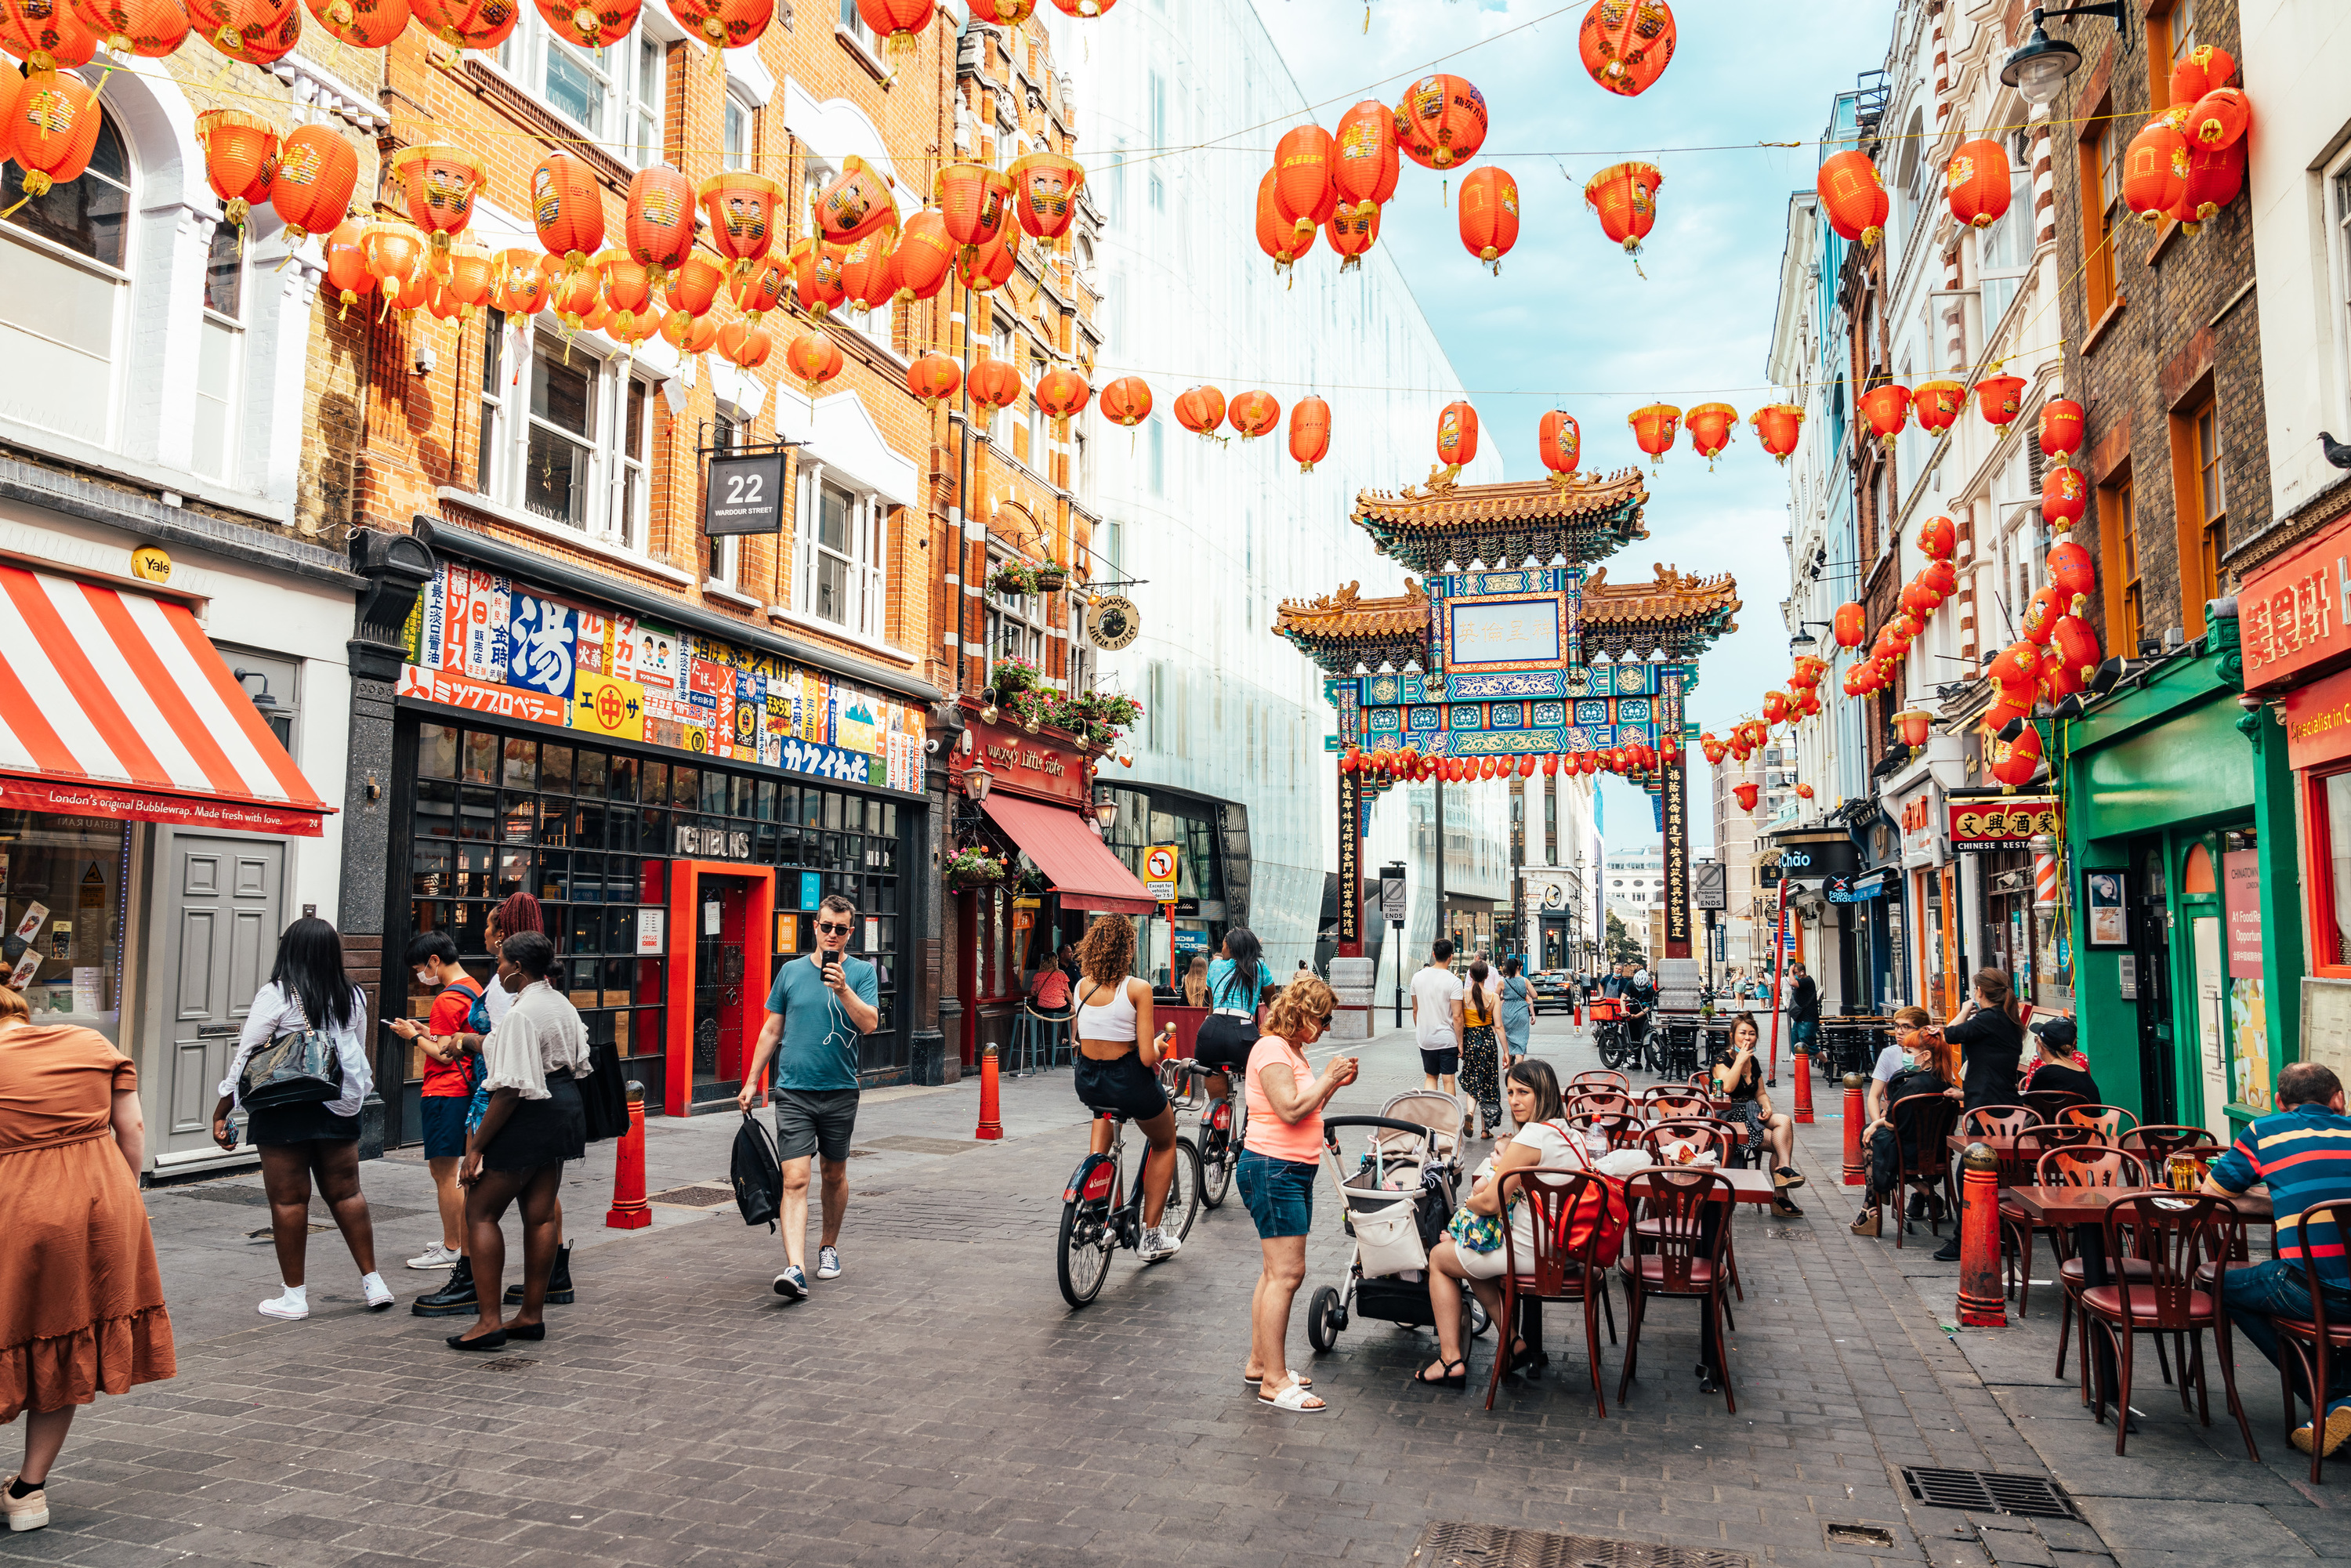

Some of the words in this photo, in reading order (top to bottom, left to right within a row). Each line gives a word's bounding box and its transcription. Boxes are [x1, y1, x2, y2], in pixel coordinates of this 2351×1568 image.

[1282, 154, 1323, 168] ABP
[726, 473, 763, 504] 22
[145, 556, 170, 574] Yale
[1457, 617, 1555, 643] 英倫呈祥
[491, 624, 509, 668] 金時
[511, 595, 574, 696] 湯
[578, 645, 602, 668] 火薬
[691, 660, 716, 694] たばこ
[600, 691, 622, 726] 中
[625, 698, 639, 719] サ
[691, 693, 715, 708] 中日新聞
[766, 695, 791, 718] 天ぷら油
[2291, 712, 2332, 744] Specialist
[2332, 708, 2342, 727] in
[784, 740, 868, 784] カクイわた
[100, 798, 133, 812] original
[135, 800, 192, 818] Bubblewrap.
[194, 806, 220, 818] Made
[222, 810, 244, 821] fresh
[245, 813, 263, 824] with
[263, 814, 283, 825] love.
[309, 819, 318, 828] 24
[1959, 812, 2056, 835] 文興酒家
[676, 825, 749, 859] ICHIBUNS
[1958, 842, 1996, 850] CHINESE
[1781, 850, 1811, 868] Chão
[2231, 867, 2259, 879] CHINATOWN
[2232, 911, 2239, 923] A1
[2240, 910, 2261, 923] Food/Re
[1094, 1175, 1110, 1188] Santander
